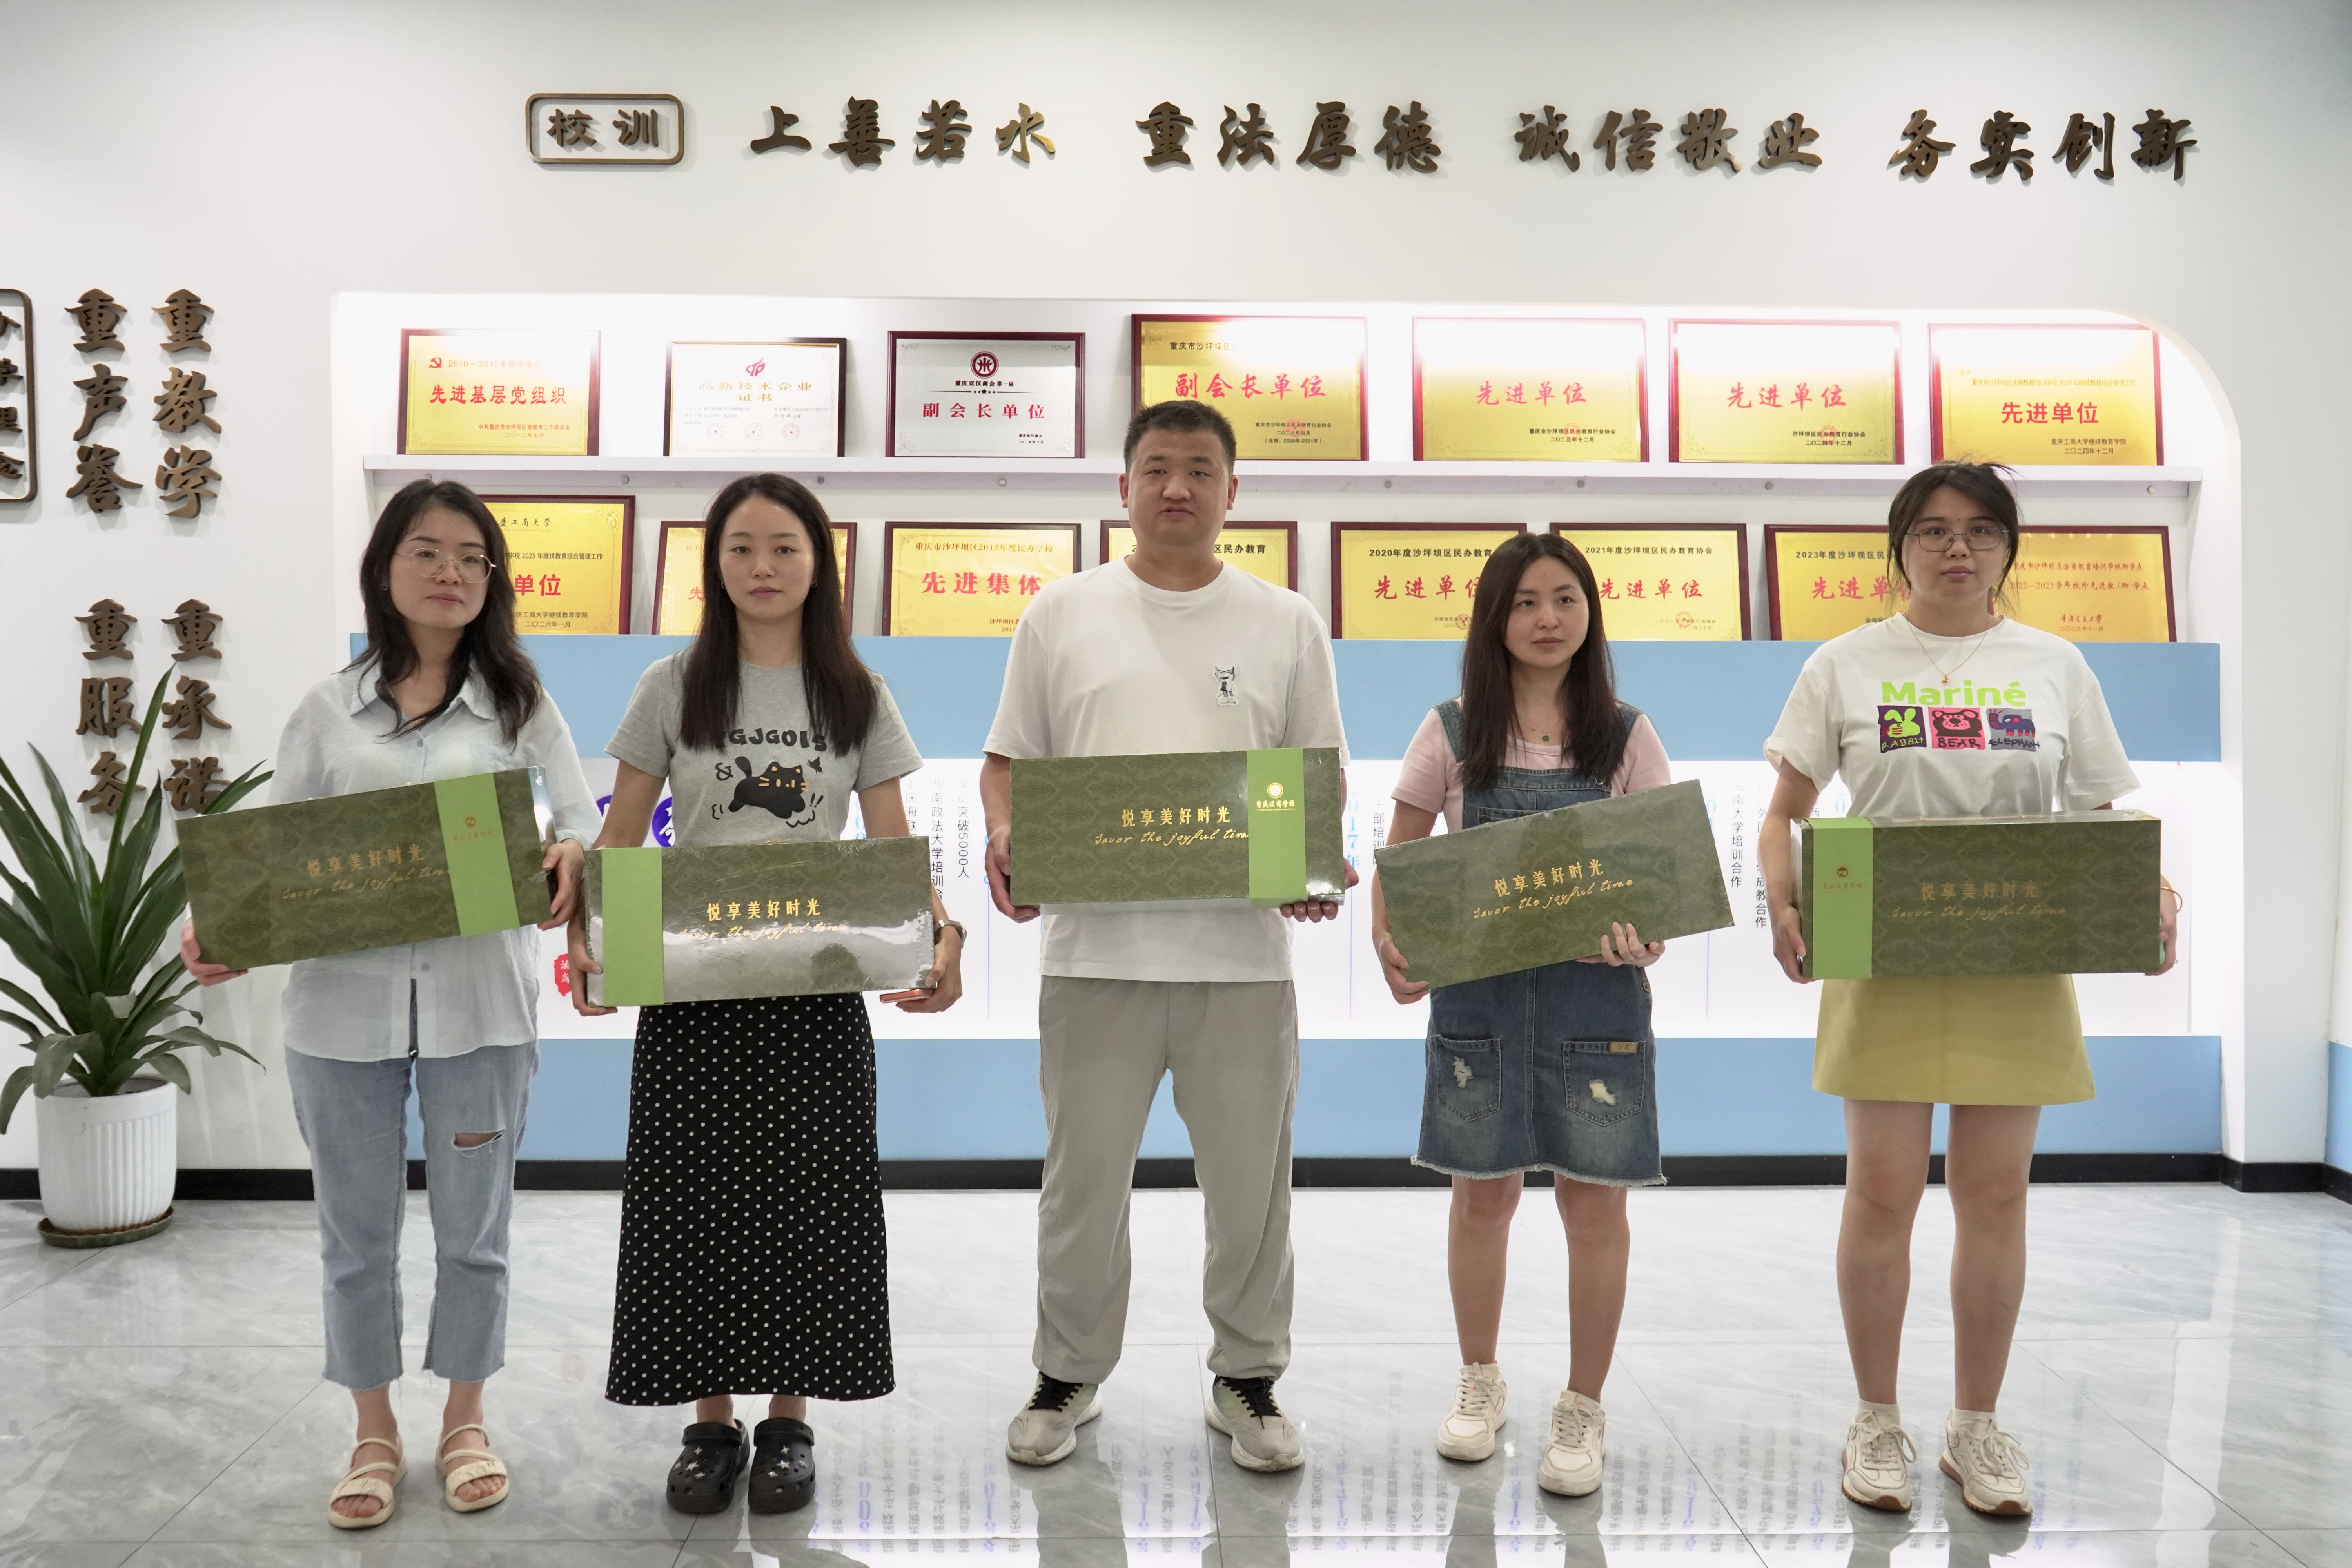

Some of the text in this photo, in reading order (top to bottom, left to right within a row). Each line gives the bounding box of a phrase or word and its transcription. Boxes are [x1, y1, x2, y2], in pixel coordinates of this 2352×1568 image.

[548, 109, 658, 147] 校训
[750, 96, 2197, 180] 上善若水 重法厚德 诚信敬业 务实创新
[430, 384, 566, 405] 先进基层党组织
[699, 382, 812, 391] 高新技术企业
[739, 393, 772, 402] 证书
[1176, 373, 1326, 401] 副会长单位
[1476, 381, 1586, 407] 先进单位
[1727, 381, 1847, 411] 先进单位
[923, 403, 1045, 419] 副会长单位
[2001, 402, 2099, 425] 先进单位
[64, 288, 146, 815] 重声誉 重服务
[152, 288, 232, 814] 重教学 重承诺
[916, 543, 1053, 553] 重庆市沙坪坝区2012年度民办学校
[1369, 548, 1492, 557] 2020年度沙坪坝区民办教育
[514, 574, 561, 596] 单位
[922, 572, 1042, 595] 先进集体
[1599, 578, 1702, 601] 先进单位
[1882, 680, 2026, 706] Mariné
[1938, 737, 1981, 748] BEAR
[1122, 806, 1230, 828] 悦享美好时光
[1140, 831, 1162, 843] the
[1164, 828, 1216, 846] joyful
[1223, 828, 1248, 840] tim
[1731, 780, 1744, 887] 海南大学培训合作
[1495, 859, 1604, 897] 悦享美好时光
[1518, 897, 1540, 909] the
[1599, 878, 1634, 890] time
[1921, 882, 2039, 902] 悦享美好时光
[707, 898, 820, 922] 悦享美好时光
